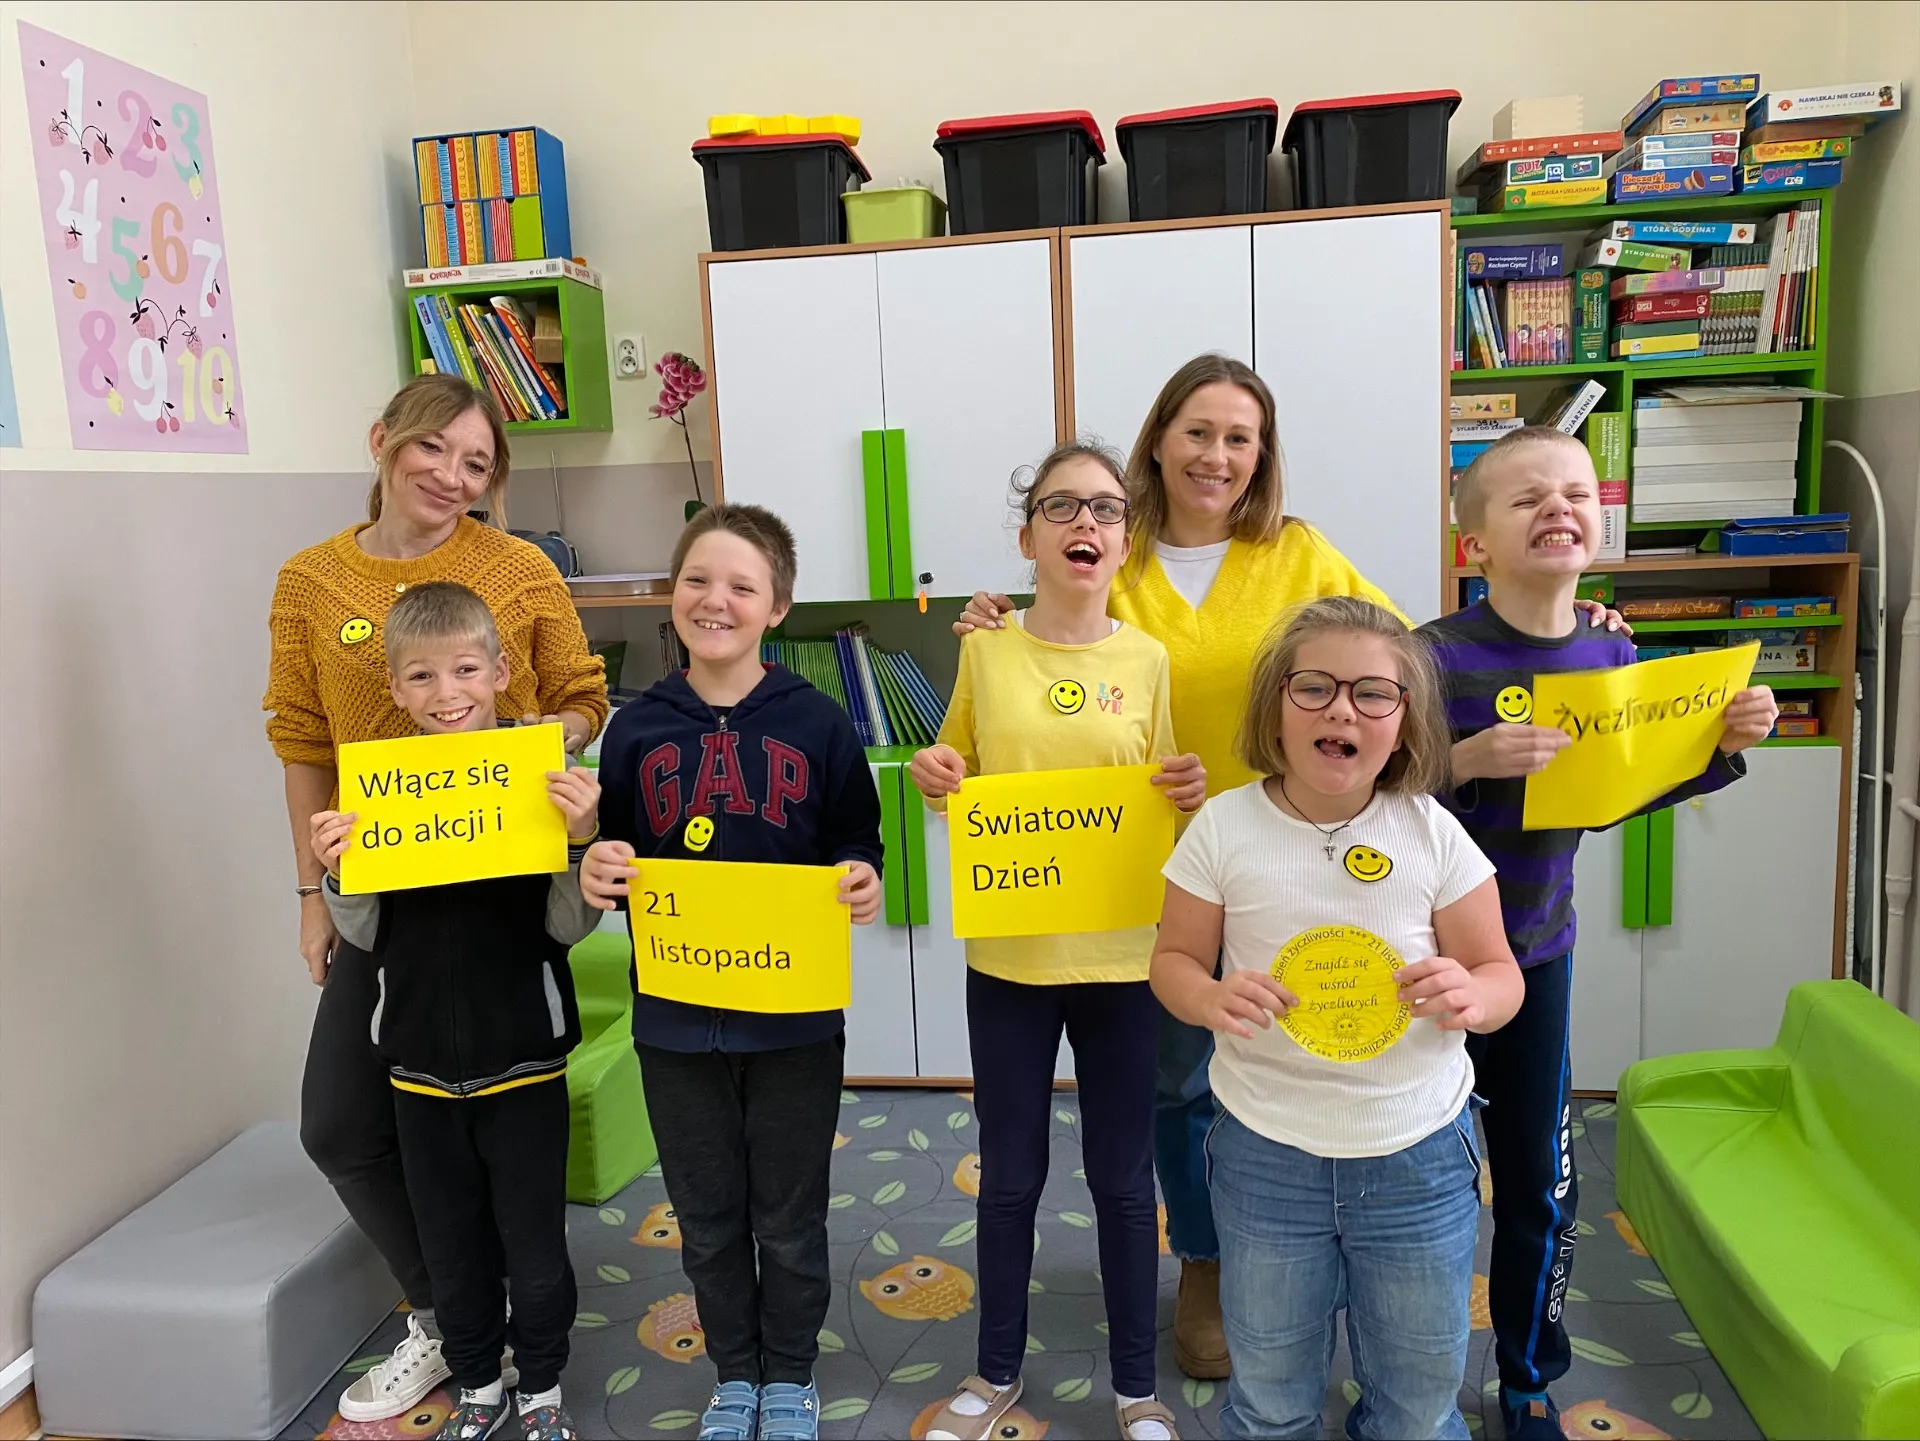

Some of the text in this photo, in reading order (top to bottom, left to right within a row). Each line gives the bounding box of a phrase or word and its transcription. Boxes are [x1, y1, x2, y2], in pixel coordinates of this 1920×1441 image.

[1799, 95, 1835, 103] NAWLEKAJ
[1850, 91, 1875, 99] CZEKAJ
[117, 90, 158, 179] 2
[171, 103, 203, 185] 3
[1515, 160, 1542, 175] QUIZ
[1622, 172, 1665, 184] Pieczątki
[55, 169, 222, 318] 4 5 6 7
[1643, 224, 1670, 233] KTÓRA
[1625, 249, 1668, 259] RYMOWANKI
[78, 310, 235, 426] 8 9 10
[1564, 394, 1596, 433] OJARZENIA
[358, 759, 510, 799] Włącz się
[639, 731, 809, 837] GAP
[362, 806, 502, 849] do akcji i
[967, 802, 1124, 838] Światowy
[972, 856, 1062, 892] Dzień
[643, 891, 681, 917] 21
[650, 935, 791, 973] listopada
[1290, 928, 1345, 957] życzliwości
[1367, 936, 1380, 951] 21
[1304, 956, 1369, 974] Znajdź się
[1320, 976, 1358, 991] wśród
[1309, 994, 1379, 1014] życzliwych
